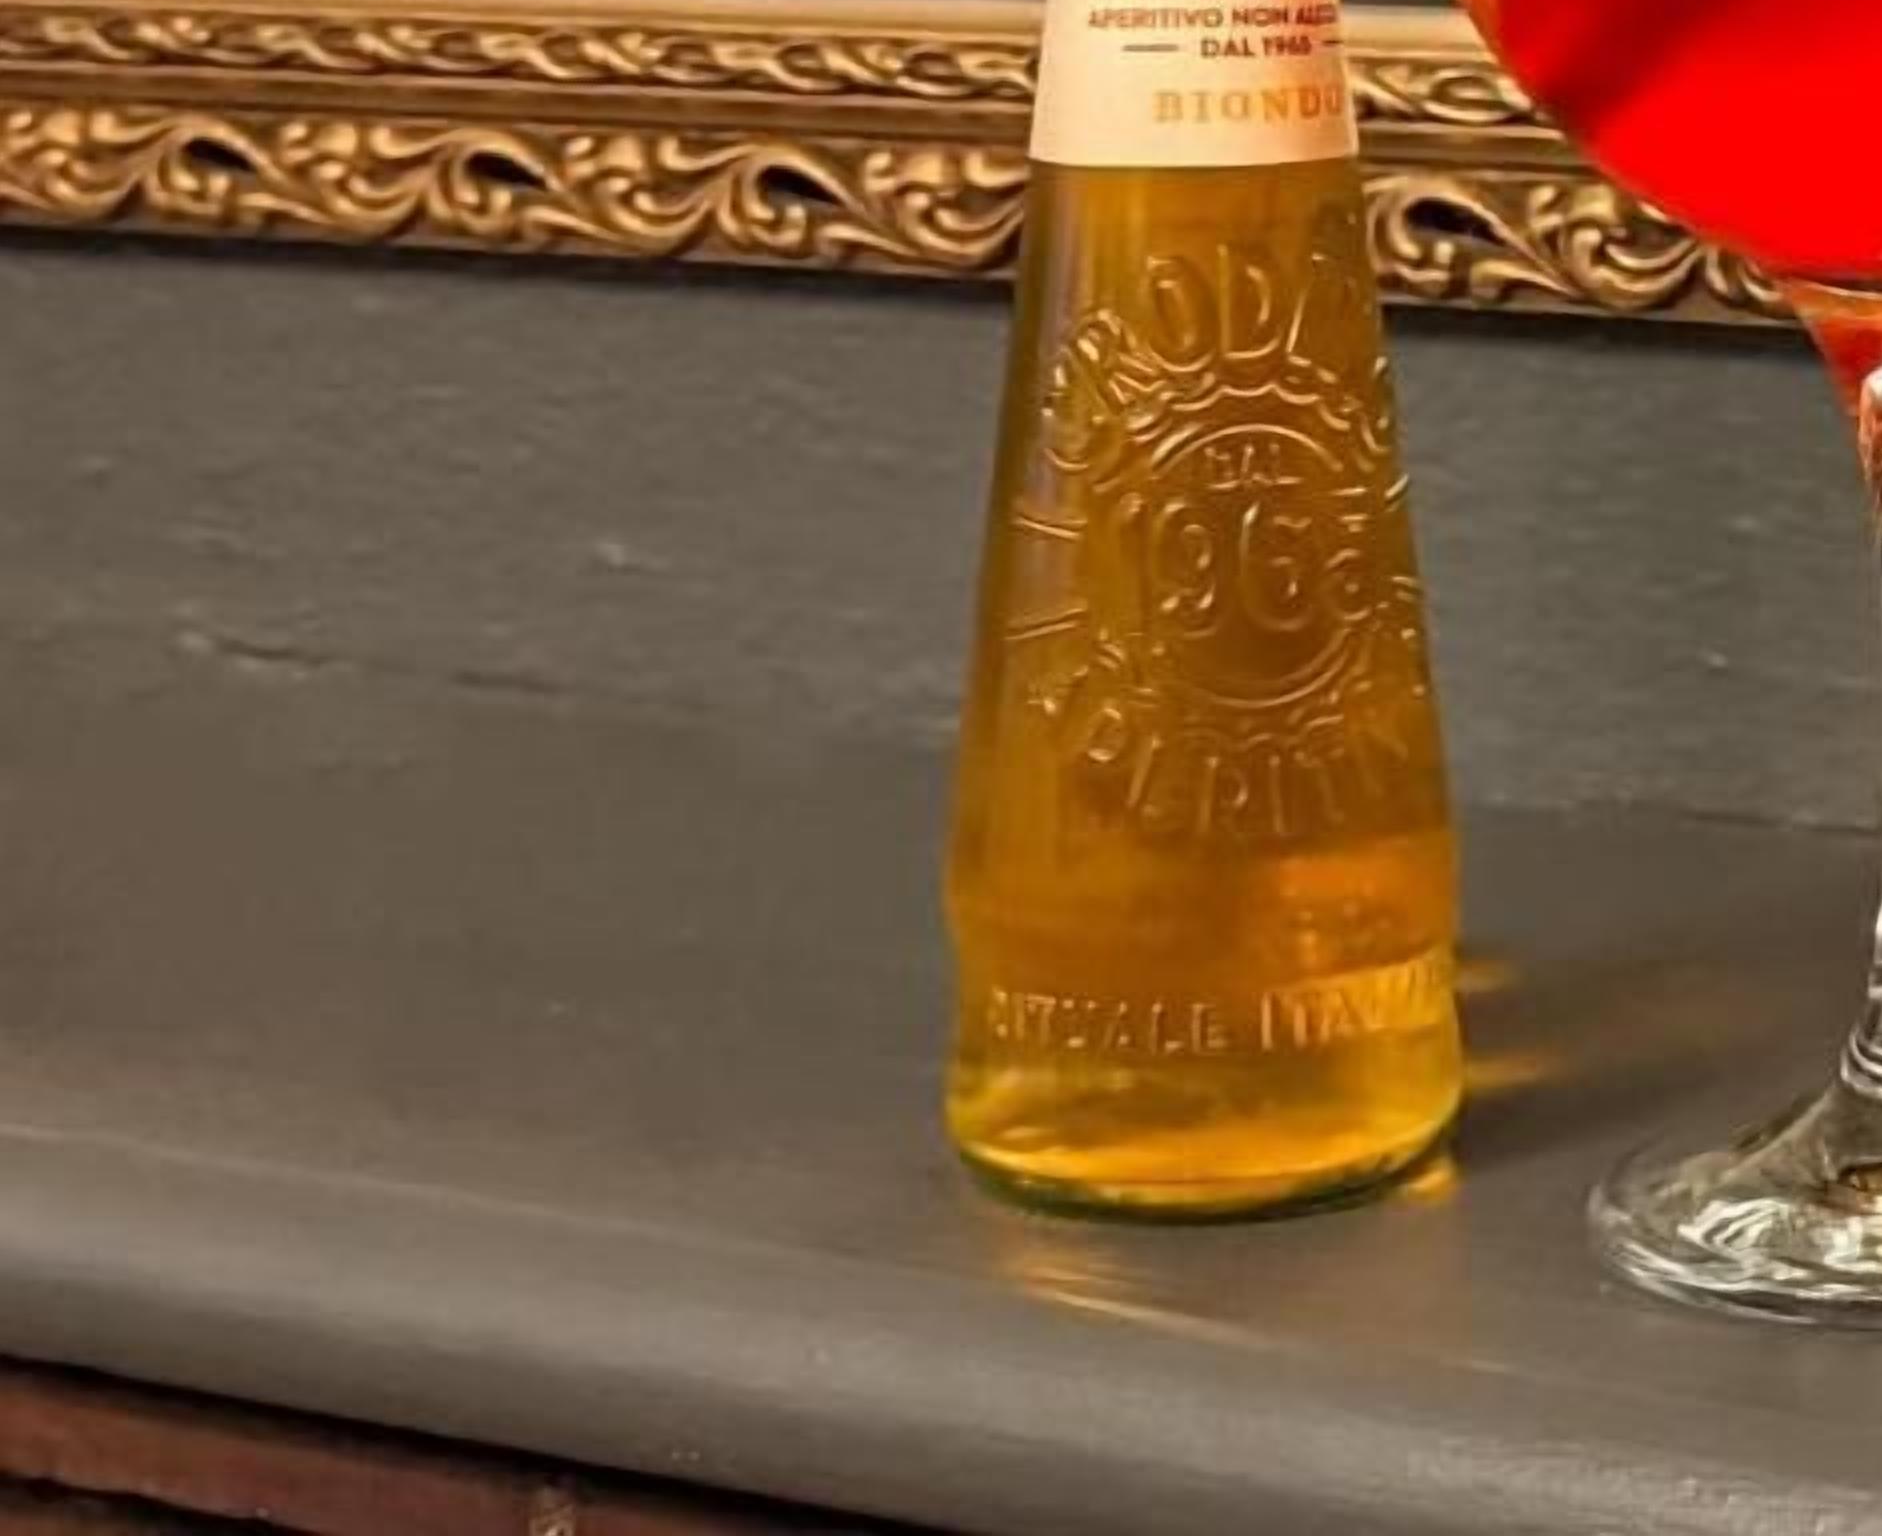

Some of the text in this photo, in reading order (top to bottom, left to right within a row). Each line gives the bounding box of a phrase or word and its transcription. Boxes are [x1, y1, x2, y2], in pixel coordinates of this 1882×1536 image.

[1088, 7, 1224, 29] APERITIVO
[1231, 7, 1289, 27] NON
[1200, 37, 1257, 58] DAL
[1155, 86, 1342, 124] BIONDO
